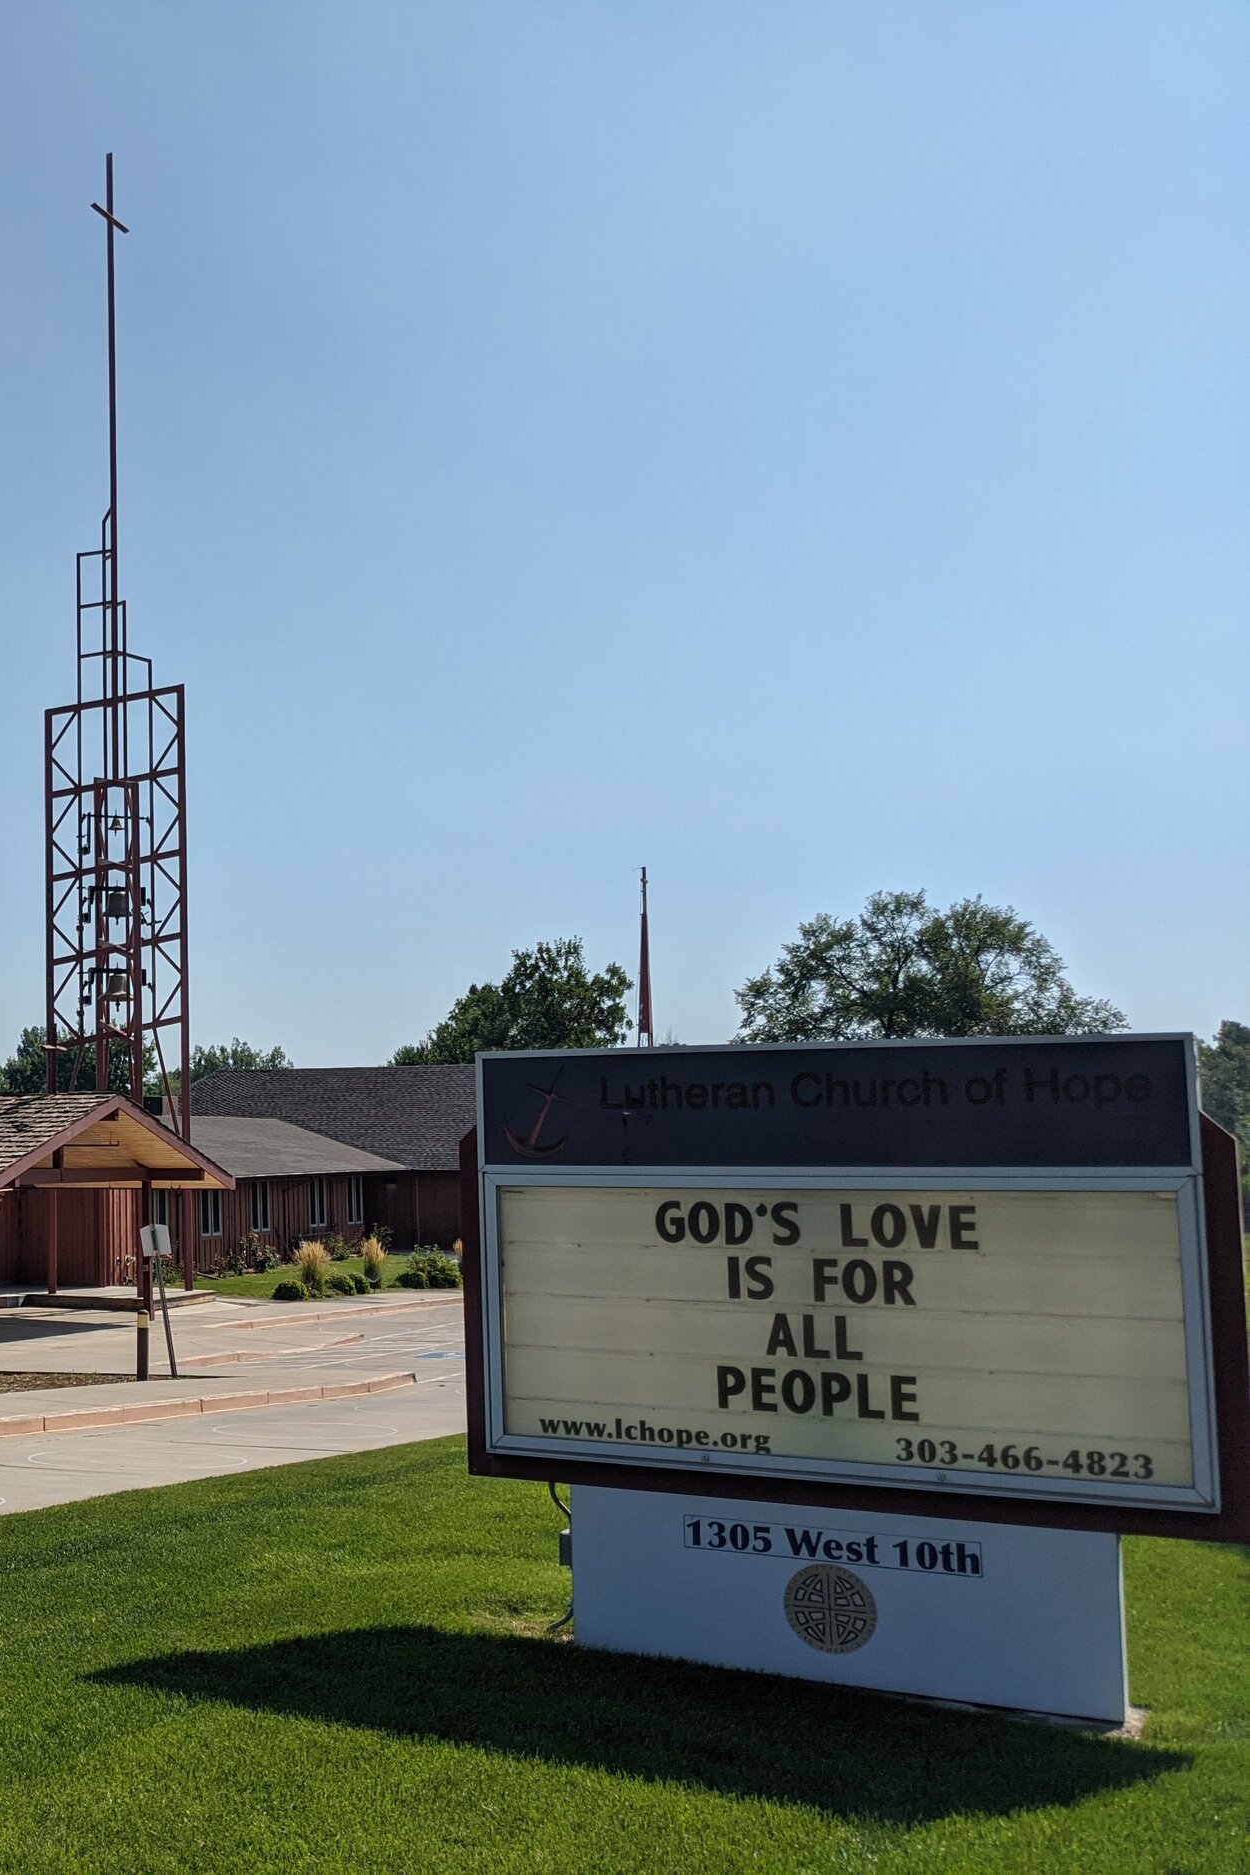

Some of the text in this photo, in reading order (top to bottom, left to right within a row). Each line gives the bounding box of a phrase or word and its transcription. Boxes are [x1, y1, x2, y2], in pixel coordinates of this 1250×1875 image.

[600, 1066, 1153, 1111] Lutheran Church of Hope
[655, 1200, 979, 1250] GOD'S LOVE
[727, 1255, 916, 1306] IS FOR
[766, 1312, 864, 1361] ALL
[716, 1365, 920, 1422] PEOPLE
[539, 1416, 771, 1456] www.lchope.org
[895, 1437, 1155, 1481] 303-466-4823
[686, 1519, 982, 1576] 1305 West 10th
